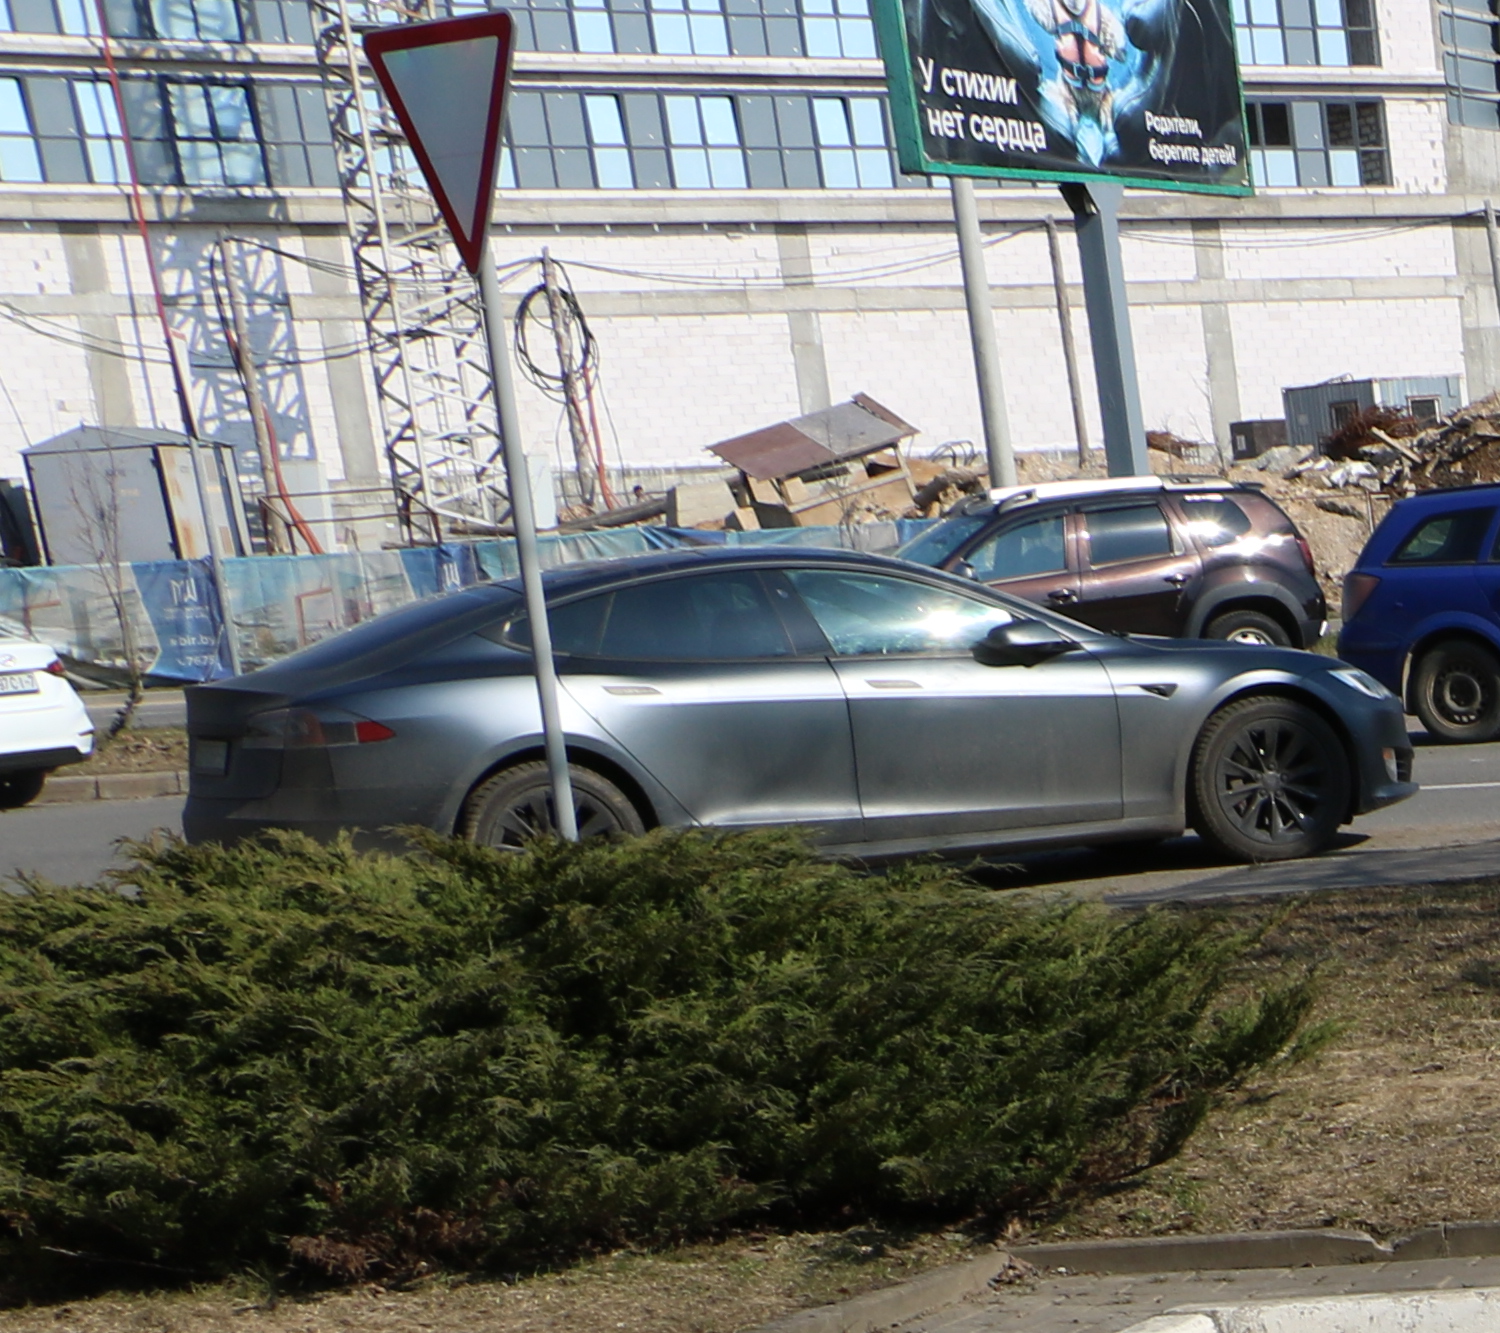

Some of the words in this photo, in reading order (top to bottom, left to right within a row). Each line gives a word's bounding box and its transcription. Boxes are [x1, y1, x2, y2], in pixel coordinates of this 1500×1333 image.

[917, 56, 934, 93] У
[941, 67, 1018, 105] стихии
[926, 107, 967, 140] нет
[969, 115, 1047, 153] сердца
[1144, 111, 1202, 139] Родители,
[1149, 140, 1200, 165] берегите
[1200, 143, 1237, 167] детей!
